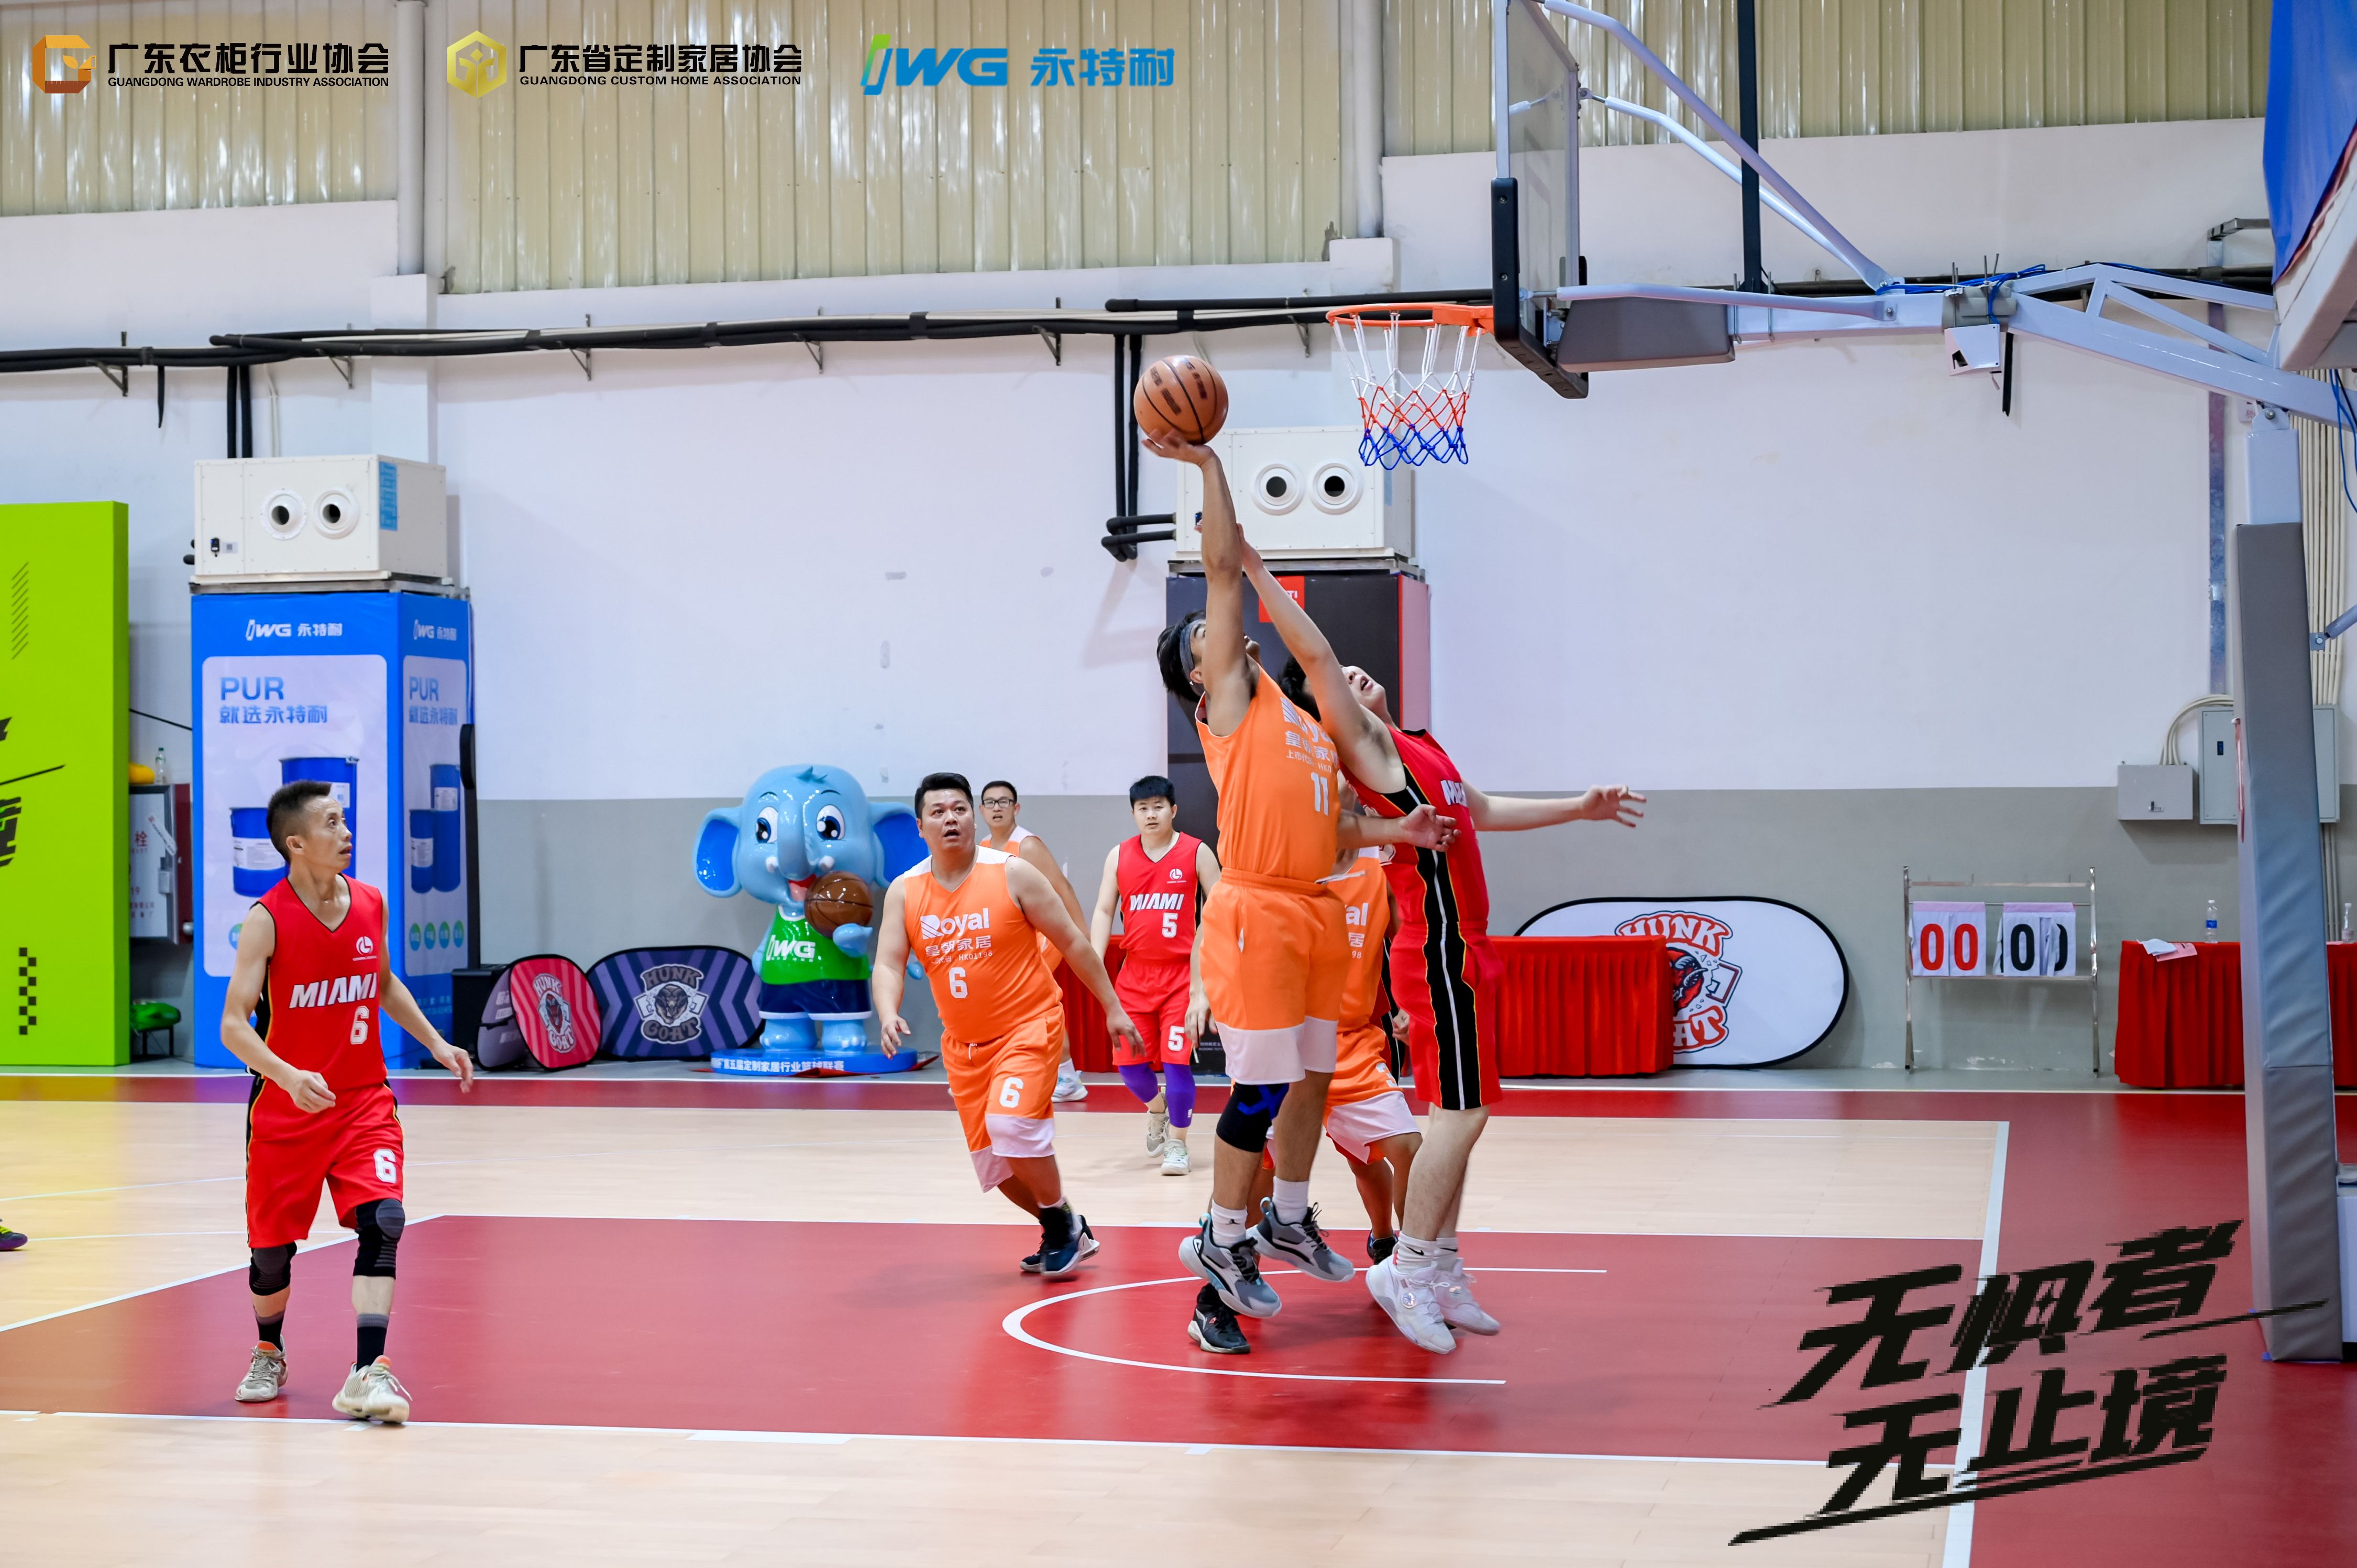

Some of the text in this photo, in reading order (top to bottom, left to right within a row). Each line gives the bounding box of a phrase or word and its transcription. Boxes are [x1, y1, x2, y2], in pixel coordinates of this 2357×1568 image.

[297, 623, 343, 637] 永特耐
[221, 677, 284, 700] PUR
[409, 676, 439, 701] PUR
[219, 705, 328, 724] 就选永特耐
[1311, 772, 1329, 816] 11
[1130, 893, 1185, 911] MIAMI
[920, 908, 989, 940] Royal
[1162, 912, 1178, 938] 5
[925, 935, 992, 957] 皇朝家居
[1920, 923, 1978, 971] 00
[289, 971, 378, 1009] MIAMI
[533, 974, 562, 995] HUNK
[643, 965, 703, 990] HUNK
[949, 967, 968, 999] 6
[350, 1006, 370, 1045] 6
[643, 1018, 701, 1042] GOAT
[549, 1028, 575, 1052] GOAT
[1168, 1025, 1185, 1052] 5
[999, 1076, 1024, 1108] 6
[373, 1149, 397, 1184] 6
